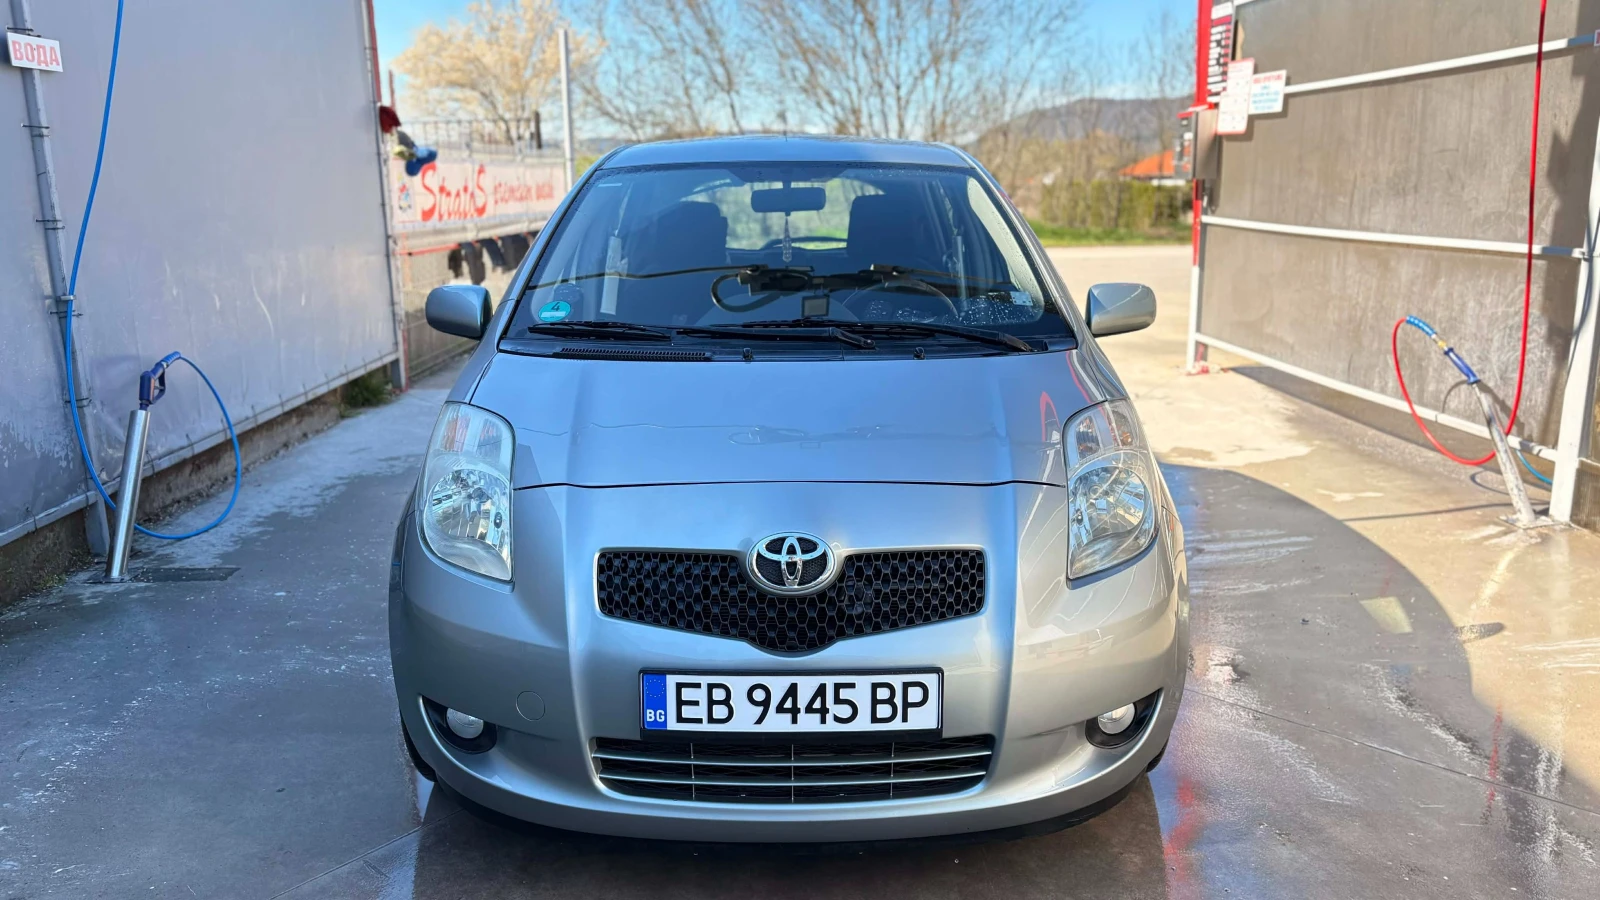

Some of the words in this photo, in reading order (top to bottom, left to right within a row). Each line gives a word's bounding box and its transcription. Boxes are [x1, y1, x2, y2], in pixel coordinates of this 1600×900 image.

[12, 40, 60, 67] ВОДА
[551, 301, 560, 311] 4
[675, 682, 735, 724] EB
[746, 682, 859, 725] 9445
[871, 682, 930, 724] BP
[646, 709, 665, 722] BG
